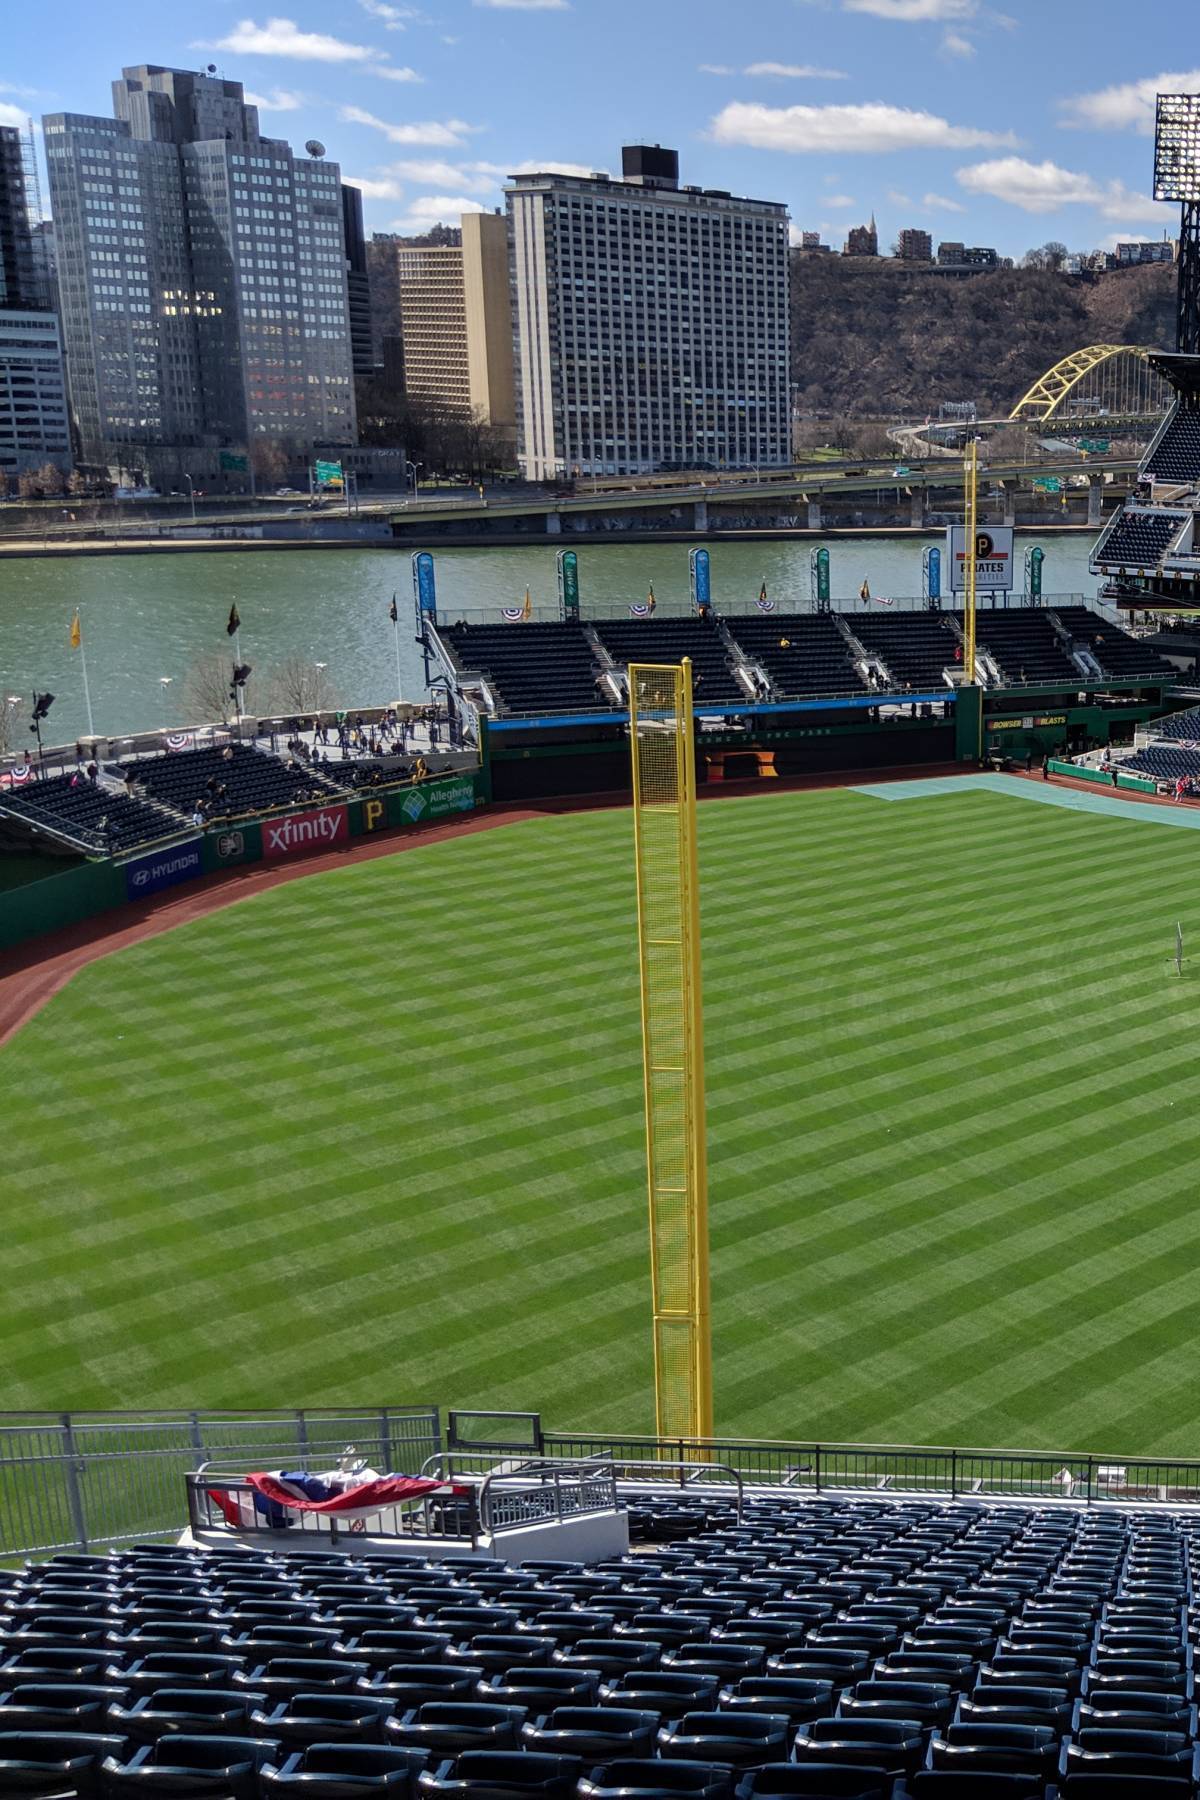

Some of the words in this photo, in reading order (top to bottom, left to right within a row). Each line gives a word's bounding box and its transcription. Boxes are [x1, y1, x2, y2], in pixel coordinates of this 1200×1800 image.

[961, 563, 1004, 572] PIATES
[993, 720, 1021, 729] BOWSER
[1040, 716, 1066, 725] BLASTS
[430, 785, 474, 803] Allegheny
[366, 801, 382, 829] P
[269, 812, 342, 851] xfinity
[152, 853, 199, 878] HYUNDAI
